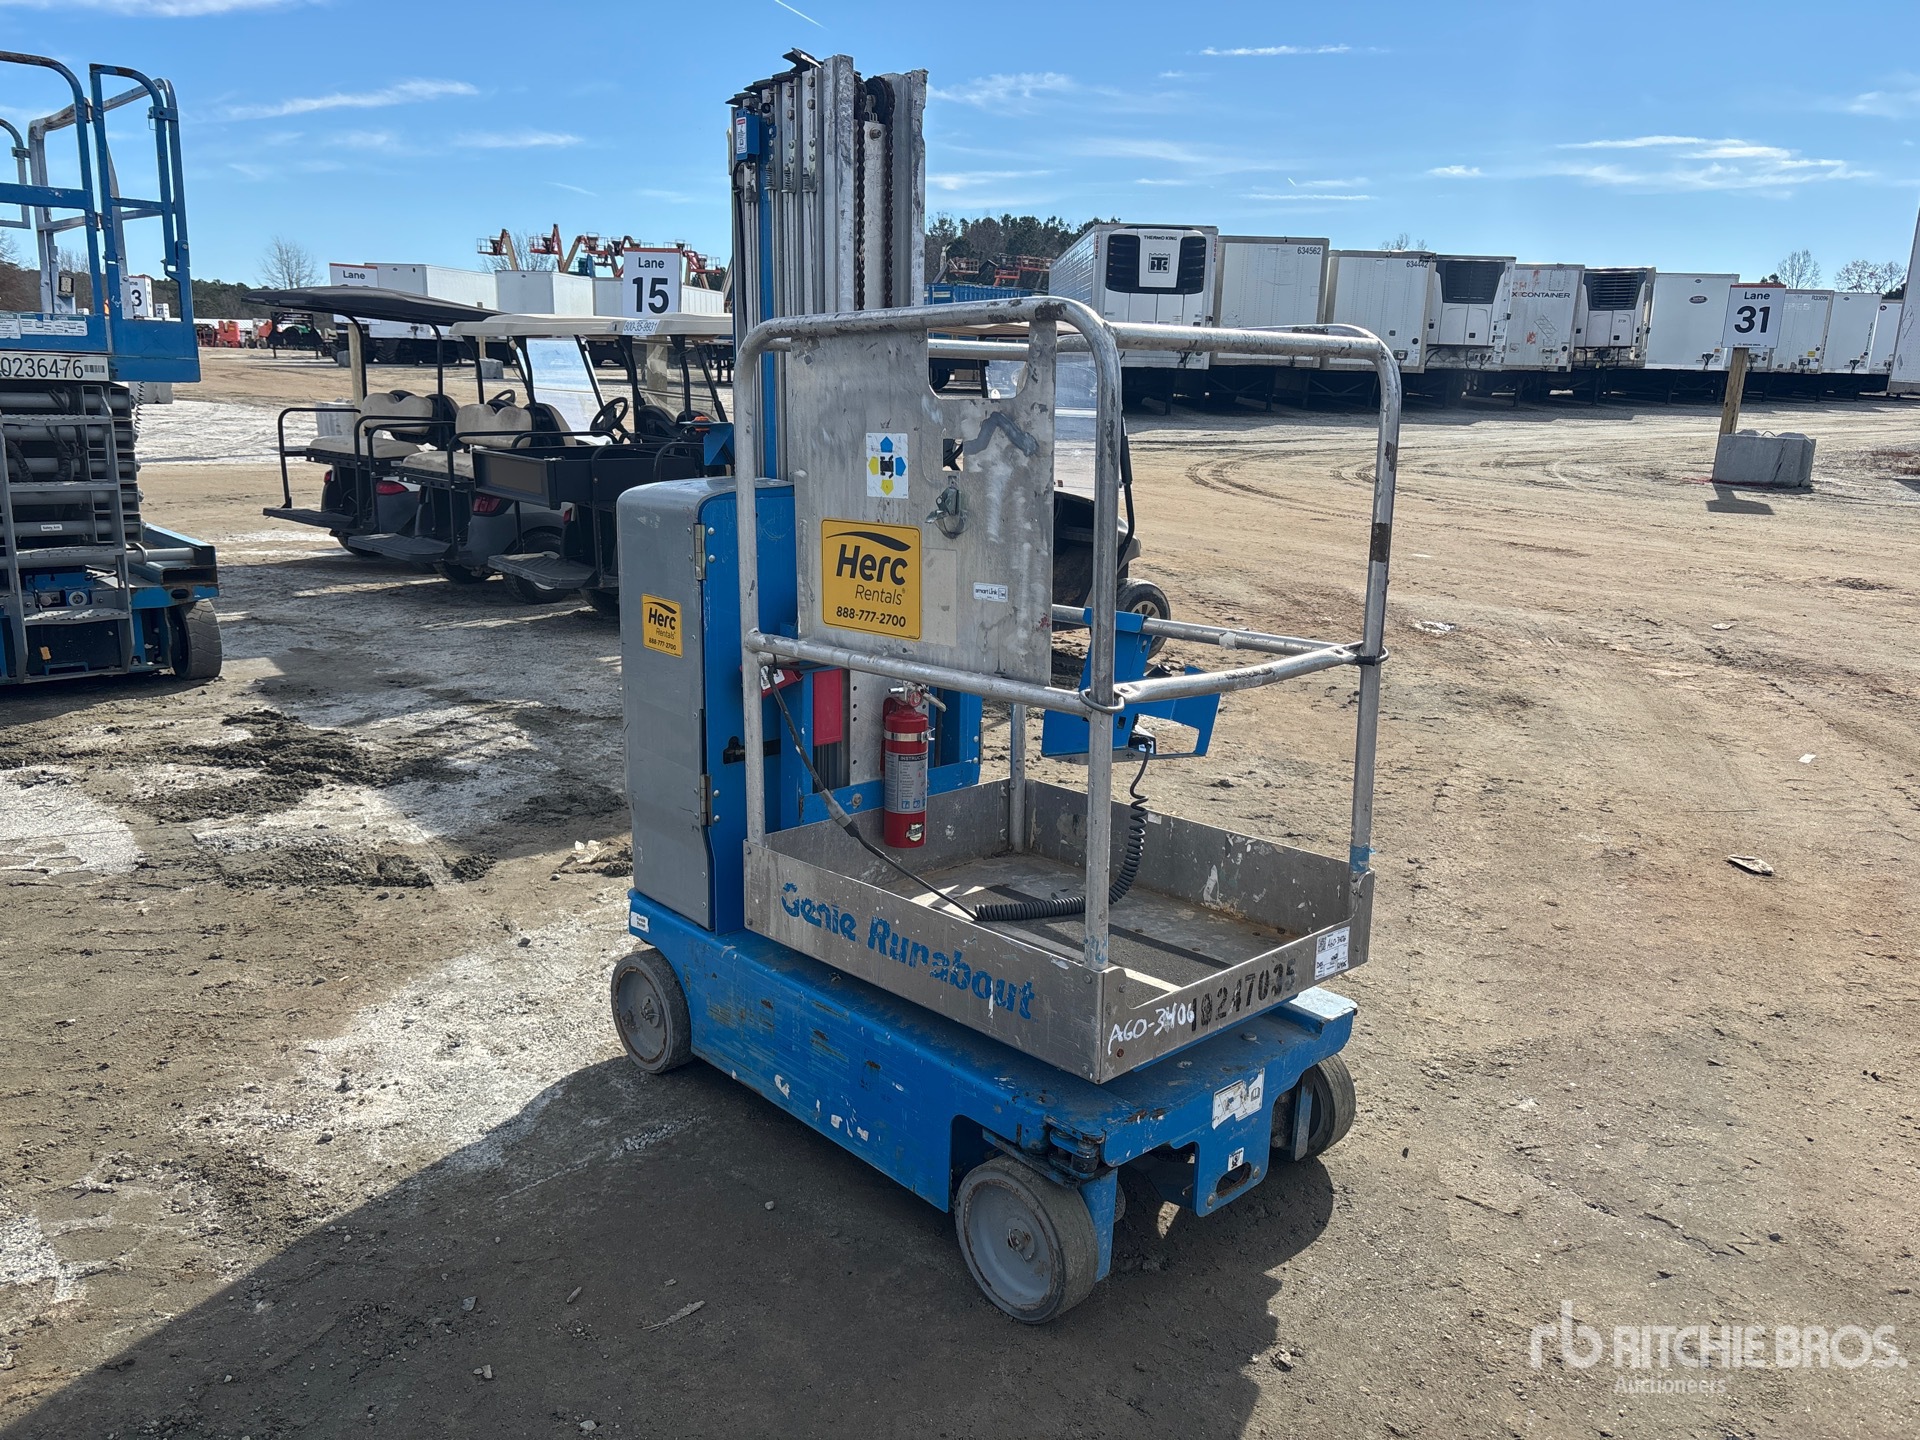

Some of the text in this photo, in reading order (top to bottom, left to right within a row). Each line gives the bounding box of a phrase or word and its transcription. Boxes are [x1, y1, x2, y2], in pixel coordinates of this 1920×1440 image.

[1297, 246, 1322, 255] 634562
[638, 257, 665, 269] Lane
[342, 270, 366, 280] Lane
[131, 289, 143, 307] 3
[632, 277, 670, 314] 15
[1521, 291, 1571, 299] CONTAINER
[1744, 291, 1771, 301] Lane
[1734, 305, 1771, 334] 31
[835, 543, 908, 586] Herc
[648, 607, 677, 631] Herc
[836, 605, 907, 628] 888-777-2700
[781, 882, 1036, 1020] Genie Runabout
